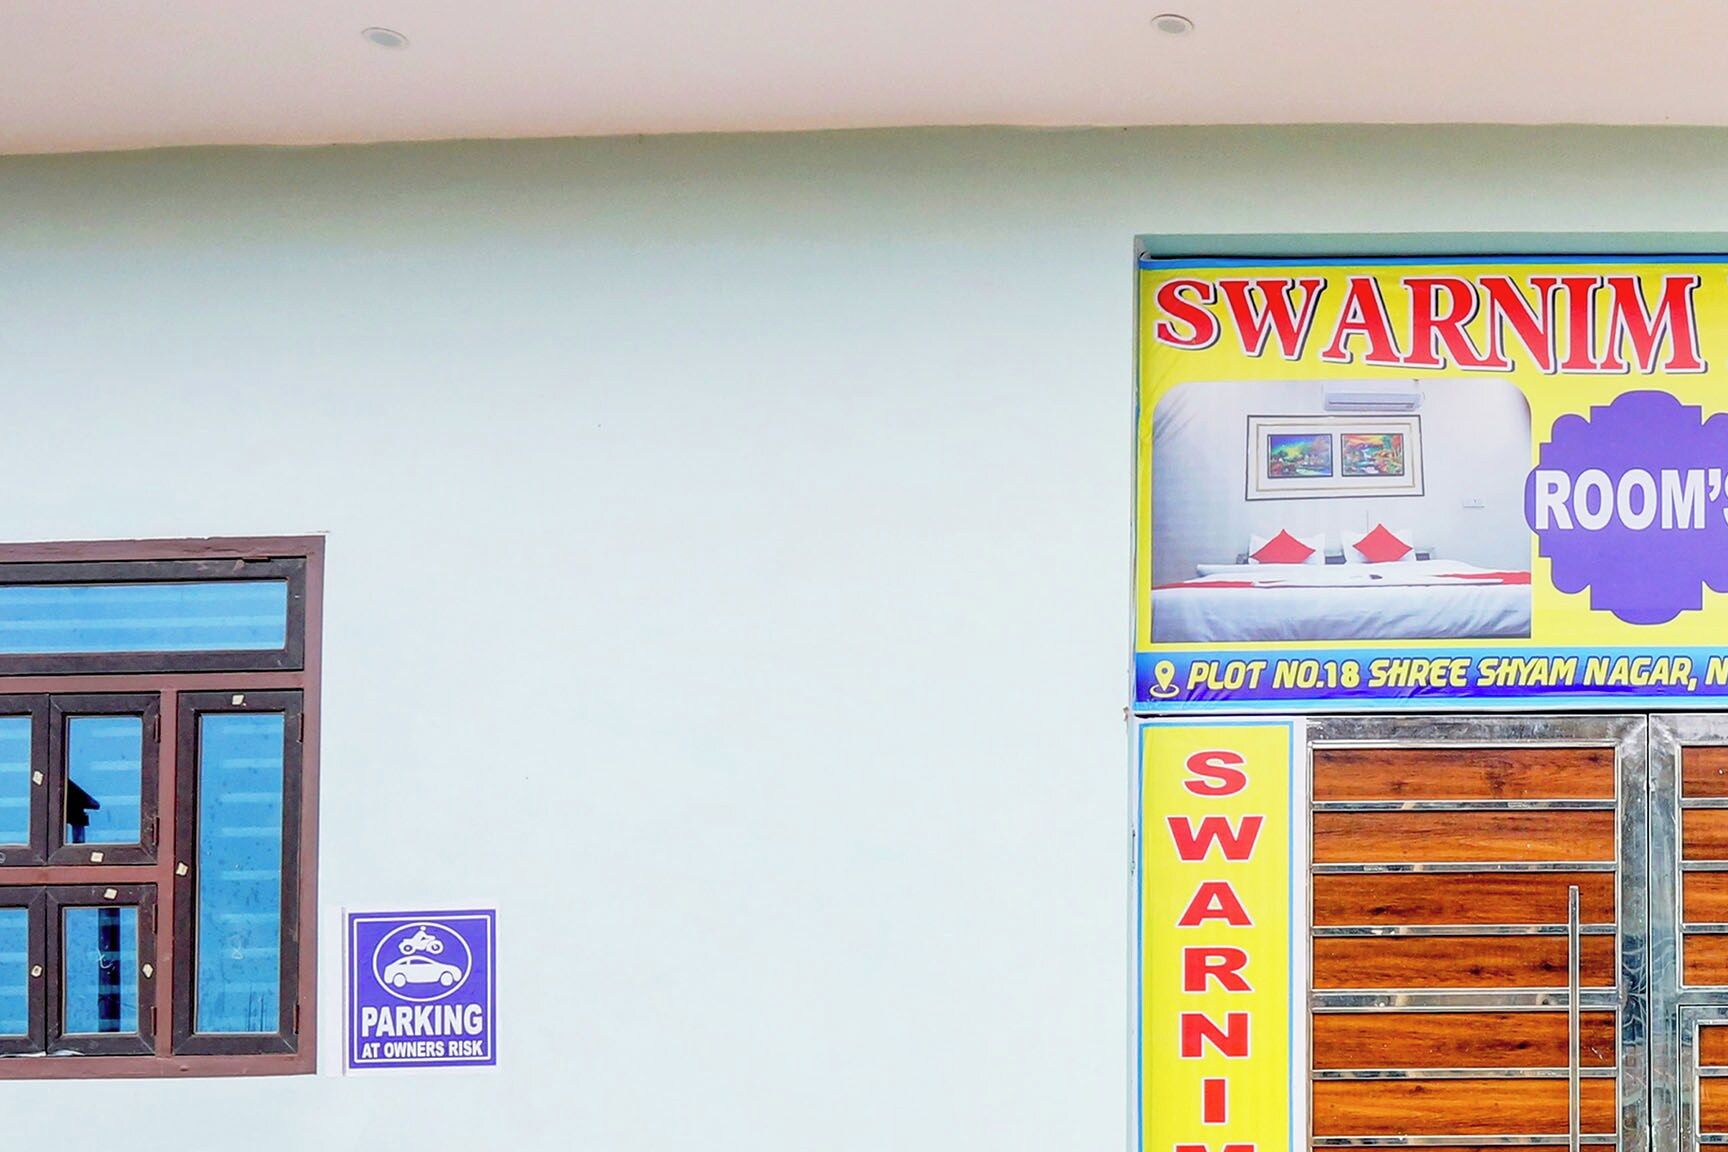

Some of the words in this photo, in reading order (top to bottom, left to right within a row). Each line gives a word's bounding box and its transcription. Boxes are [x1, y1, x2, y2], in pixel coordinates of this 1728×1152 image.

[1154, 276, 1706, 374] SWARNIM
[1186, 660, 1267, 691] PLOT
[1272, 660, 1360, 689] NO.18
[1367, 657, 1470, 688] SHREE
[1477, 656, 1578, 688] SHYAM
[1584, 656, 1698, 691] NAGAR,
[361, 1003, 484, 1038] PARKING
[361, 1042, 381, 1059] AT
[383, 1040, 446, 1058] OWNERS
[448, 1039, 484, 1057] RISK
